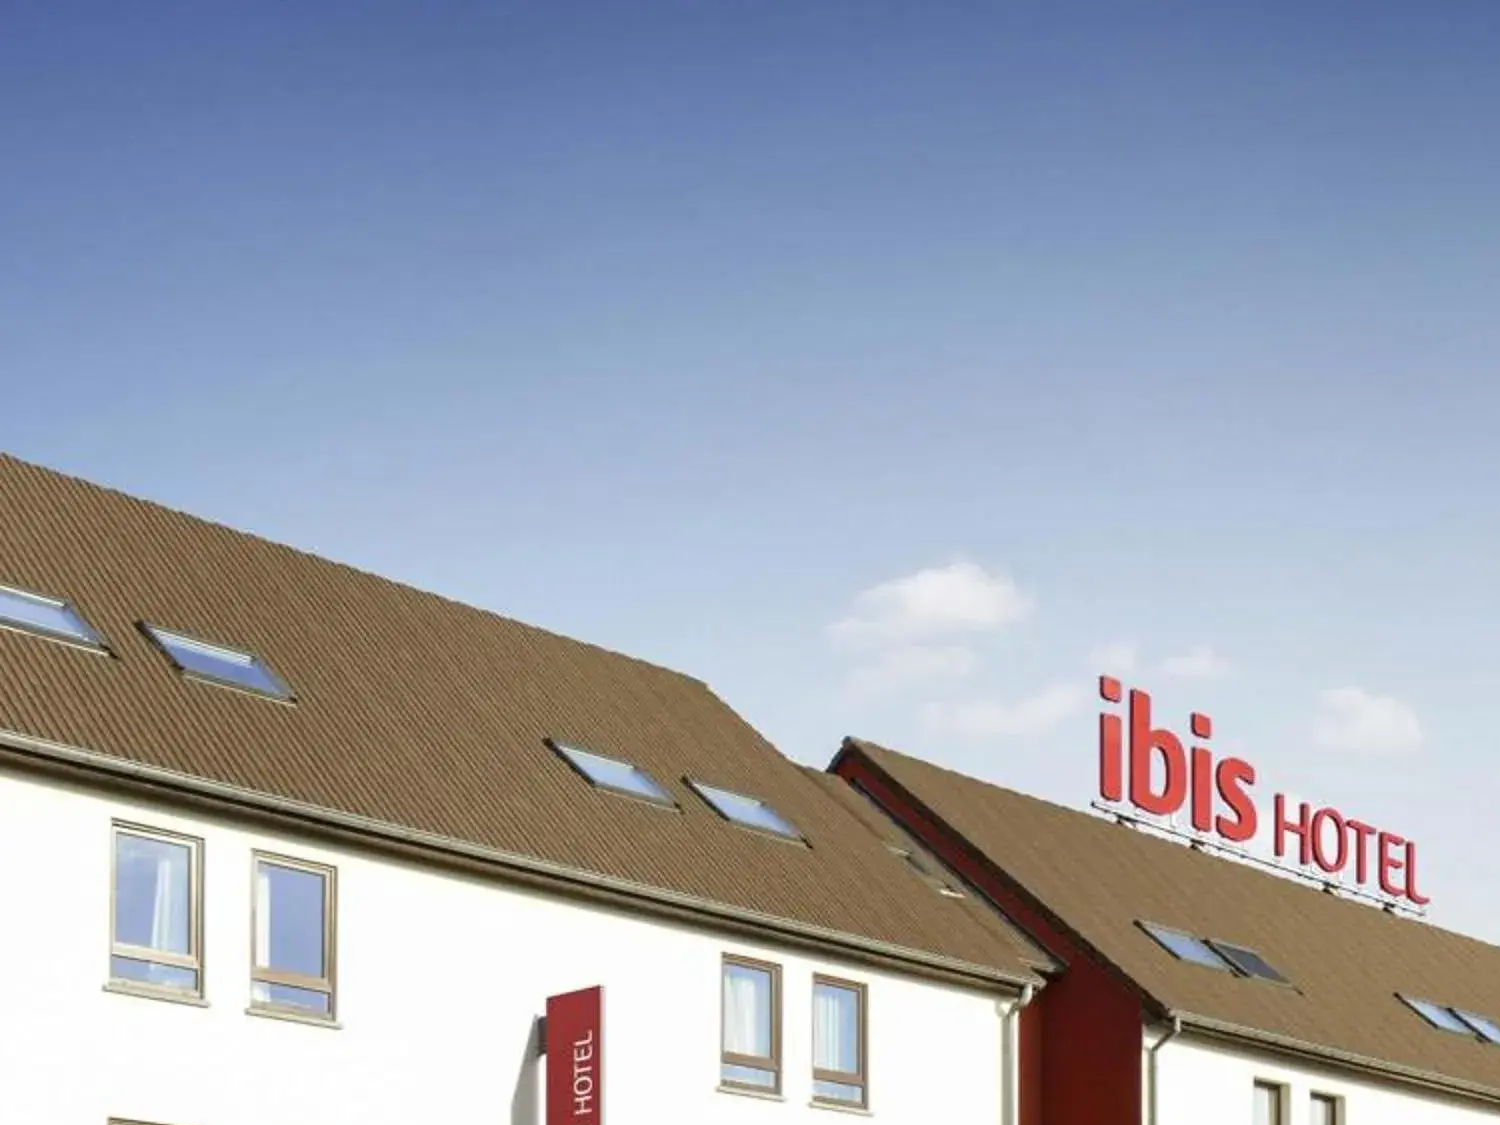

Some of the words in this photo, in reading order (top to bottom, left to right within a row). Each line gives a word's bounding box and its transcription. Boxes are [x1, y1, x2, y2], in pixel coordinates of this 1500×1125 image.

[1099, 674, 1258, 842] ibis
[1274, 793, 1430, 905] HOTEL
[573, 1030, 592, 1116] HOTEL
